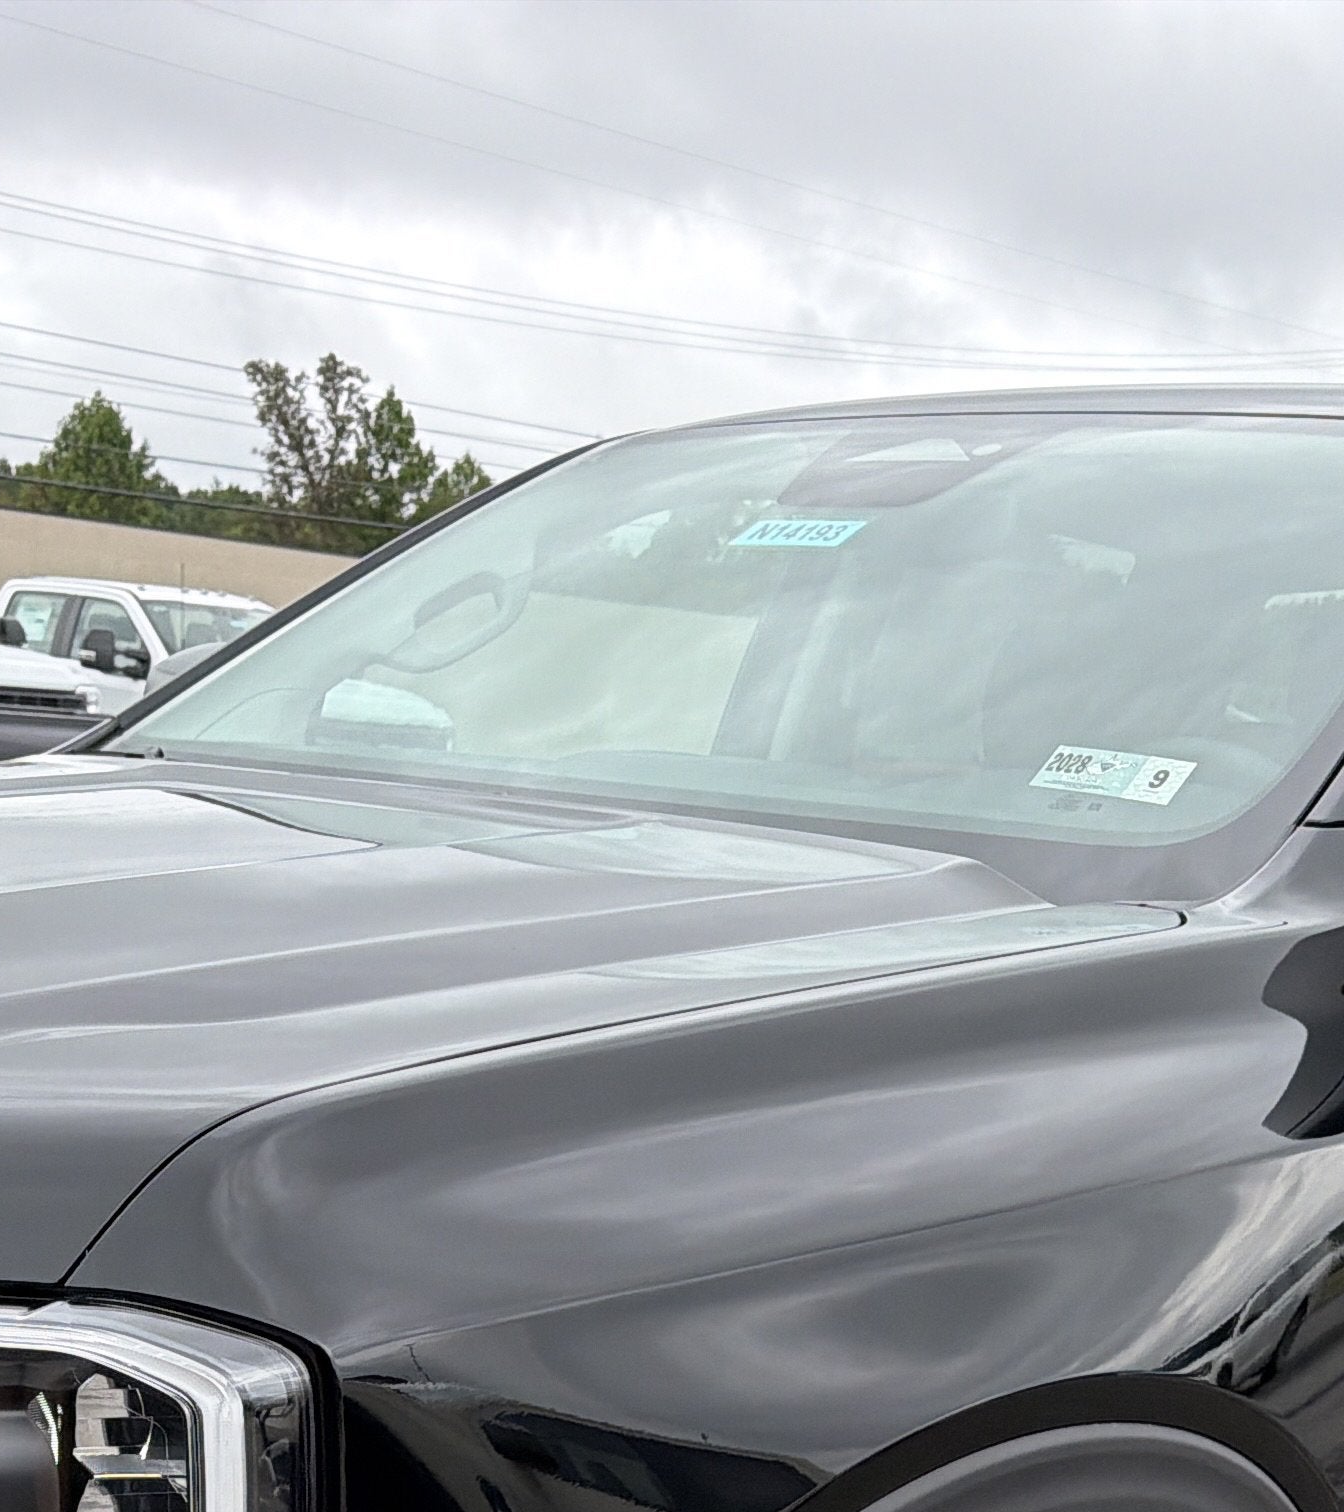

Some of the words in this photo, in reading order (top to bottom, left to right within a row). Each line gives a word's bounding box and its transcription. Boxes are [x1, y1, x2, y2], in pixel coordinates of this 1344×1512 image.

[746, 522, 848, 542] N14193
[1044, 752, 1093, 774] 2028
[1148, 769, 1170, 789] 9
